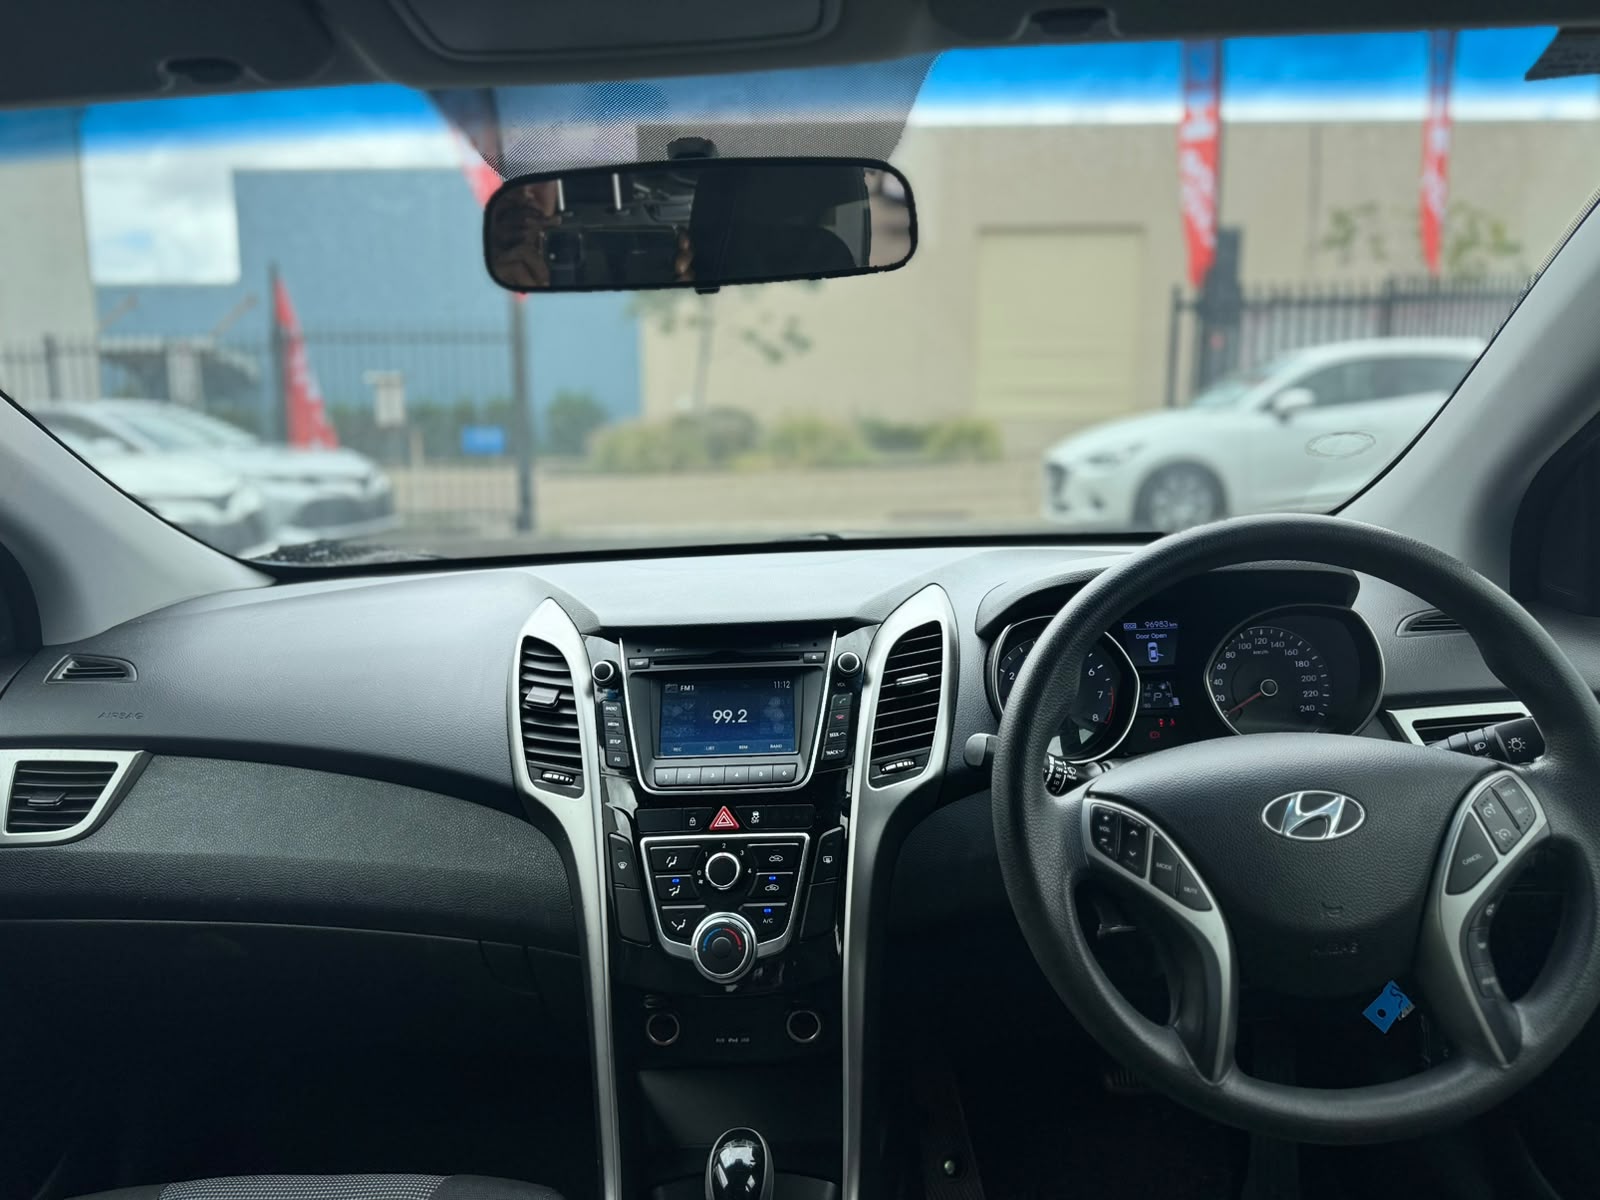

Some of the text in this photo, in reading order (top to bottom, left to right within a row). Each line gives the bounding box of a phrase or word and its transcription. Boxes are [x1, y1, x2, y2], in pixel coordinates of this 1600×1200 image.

[1144, 620, 1169, 629] 96983
[1150, 632, 1168, 640] Open
[1254, 637, 1268, 645] 120
[1270, 640, 1285, 649] 140
[1238, 642, 1252, 650] 100
[1225, 651, 1236, 659] 80
[1284, 648, 1298, 657] 160
[1216, 662, 1227, 671] 60
[1294, 660, 1310, 668] 180
[1008, 671, 1016, 681] 2
[1088, 668, 1096, 677] 6
[1213, 678, 1224, 687] 40
[1301, 674, 1317, 683] 200
[773, 680, 791, 689] 11:12
[1097, 690, 1104, 700] 7
[1215, 694, 1226, 703] 20
[1302, 690, 1319, 698] 220
[1299, 704, 1316, 713] 240
[712, 709, 748, 725] 99.2
[1091, 713, 1100, 722] 8
